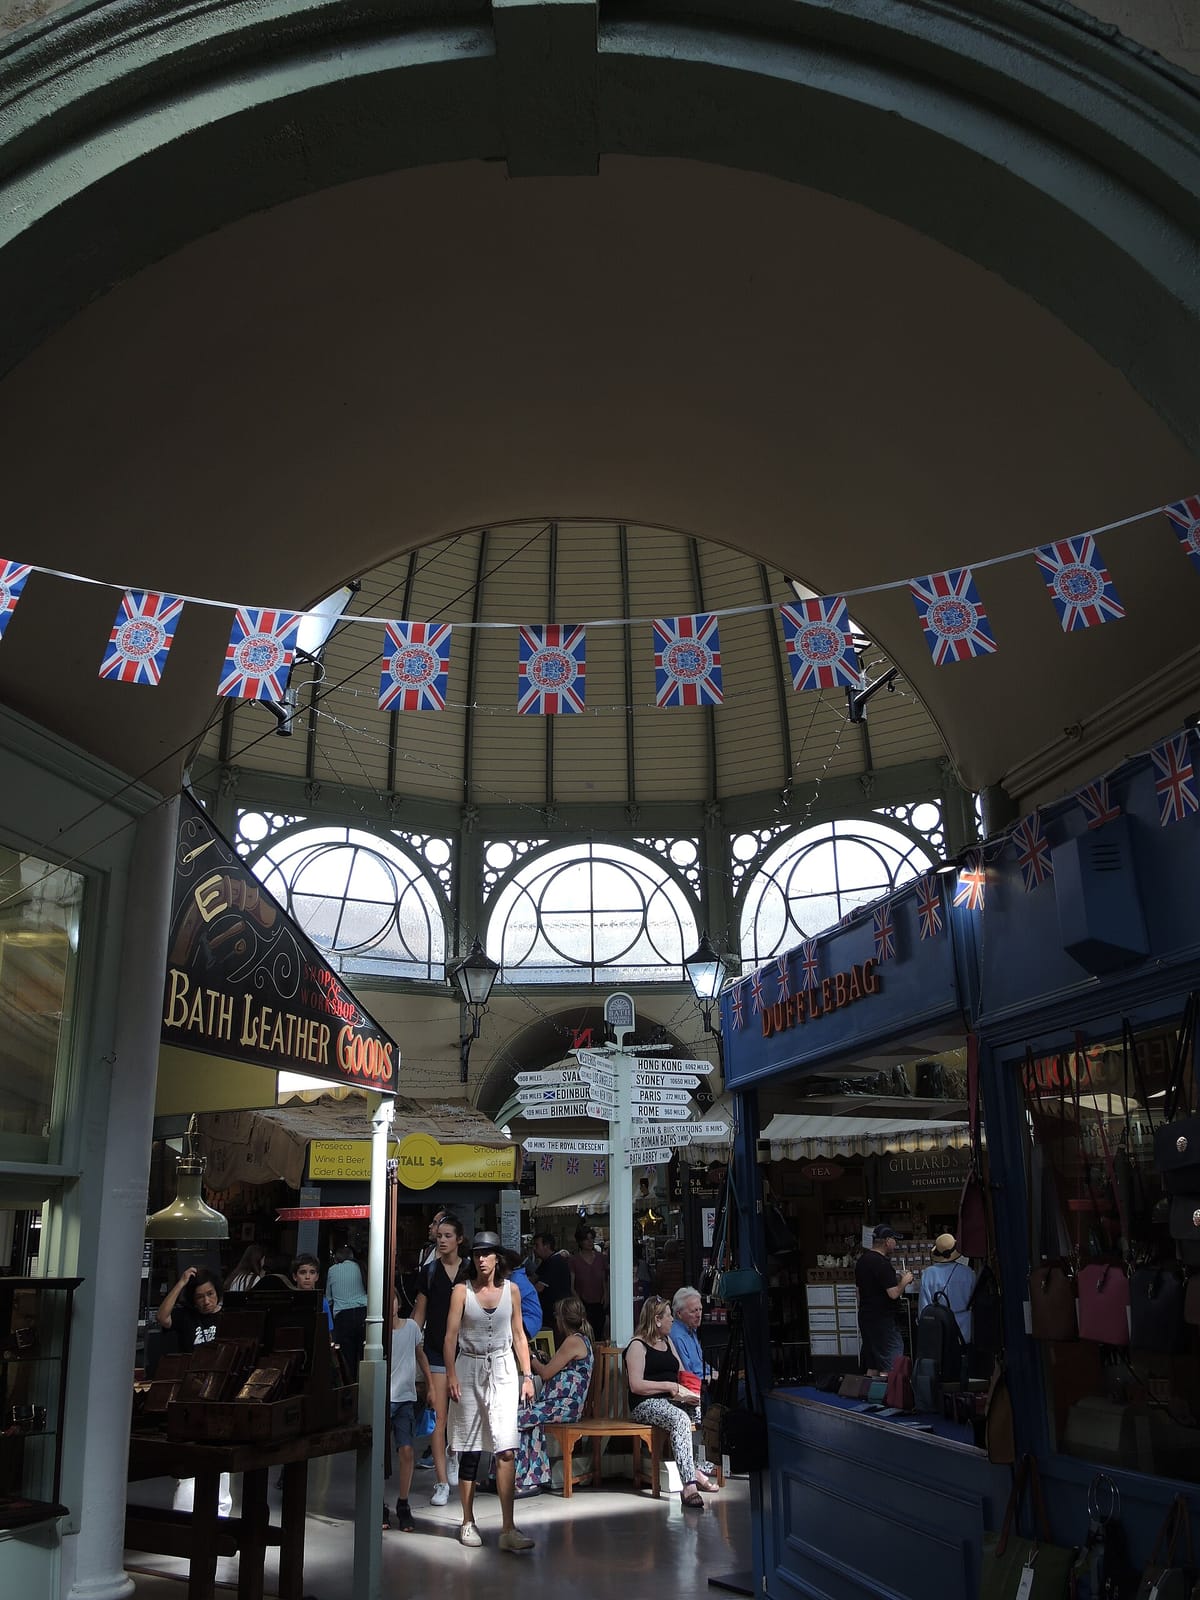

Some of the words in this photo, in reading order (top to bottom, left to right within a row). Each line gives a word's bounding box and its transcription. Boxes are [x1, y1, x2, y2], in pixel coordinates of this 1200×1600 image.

[303, 963, 331, 987] SHOP
[762, 958, 879, 1037] DUFFLEBAG
[300, 987, 355, 1020] WORKSHOP
[163, 968, 233, 1041] BATH
[239, 993, 331, 1065] LEATHER
[336, 1024, 394, 1083] GOODS
[638, 1059, 659, 1071] HONG
[661, 1060, 682, 1072] KONG
[636, 1074, 665, 1086] SYDNEY
[639, 1090, 661, 1101] PARIS
[638, 1106, 660, 1117] ROME
[638, 1126, 656, 1135] TRAIN
[657, 1126, 662, 1134] &
[664, 1126, 675, 1134] BUS
[676, 1125, 703, 1134] STATIONS
[315, 1141, 353, 1150] Prosecco
[548, 1141, 558, 1150] THE
[560, 1142, 577, 1150] ROYAL
[578, 1143, 604, 1151] CRESCENT
[631, 1137, 641, 1149] THE
[641, 1135, 660, 1148] ROMAN
[660, 1133, 677, 1146] BATHS
[315, 1155, 336, 1163] Wine
[337, 1155, 344, 1164] &
[346, 1155, 365, 1164] Beer
[429, 1156, 444, 1167] 54
[485, 1158, 512, 1167] Coffee
[630, 1152, 641, 1164] BATH
[642, 1151, 658, 1163] ABBEY
[313, 1167, 336, 1176] Cider
[337, 1167, 343, 1176] &
[454, 1170, 478, 1178] Loose
[479, 1170, 496, 1178] Leaf
[497, 1170, 512, 1178] Tea
[811, 1167, 832, 1176] TEA
[912, 1177, 947, 1186] SPECIALITY
[947, 1177, 960, 1185] TEA
